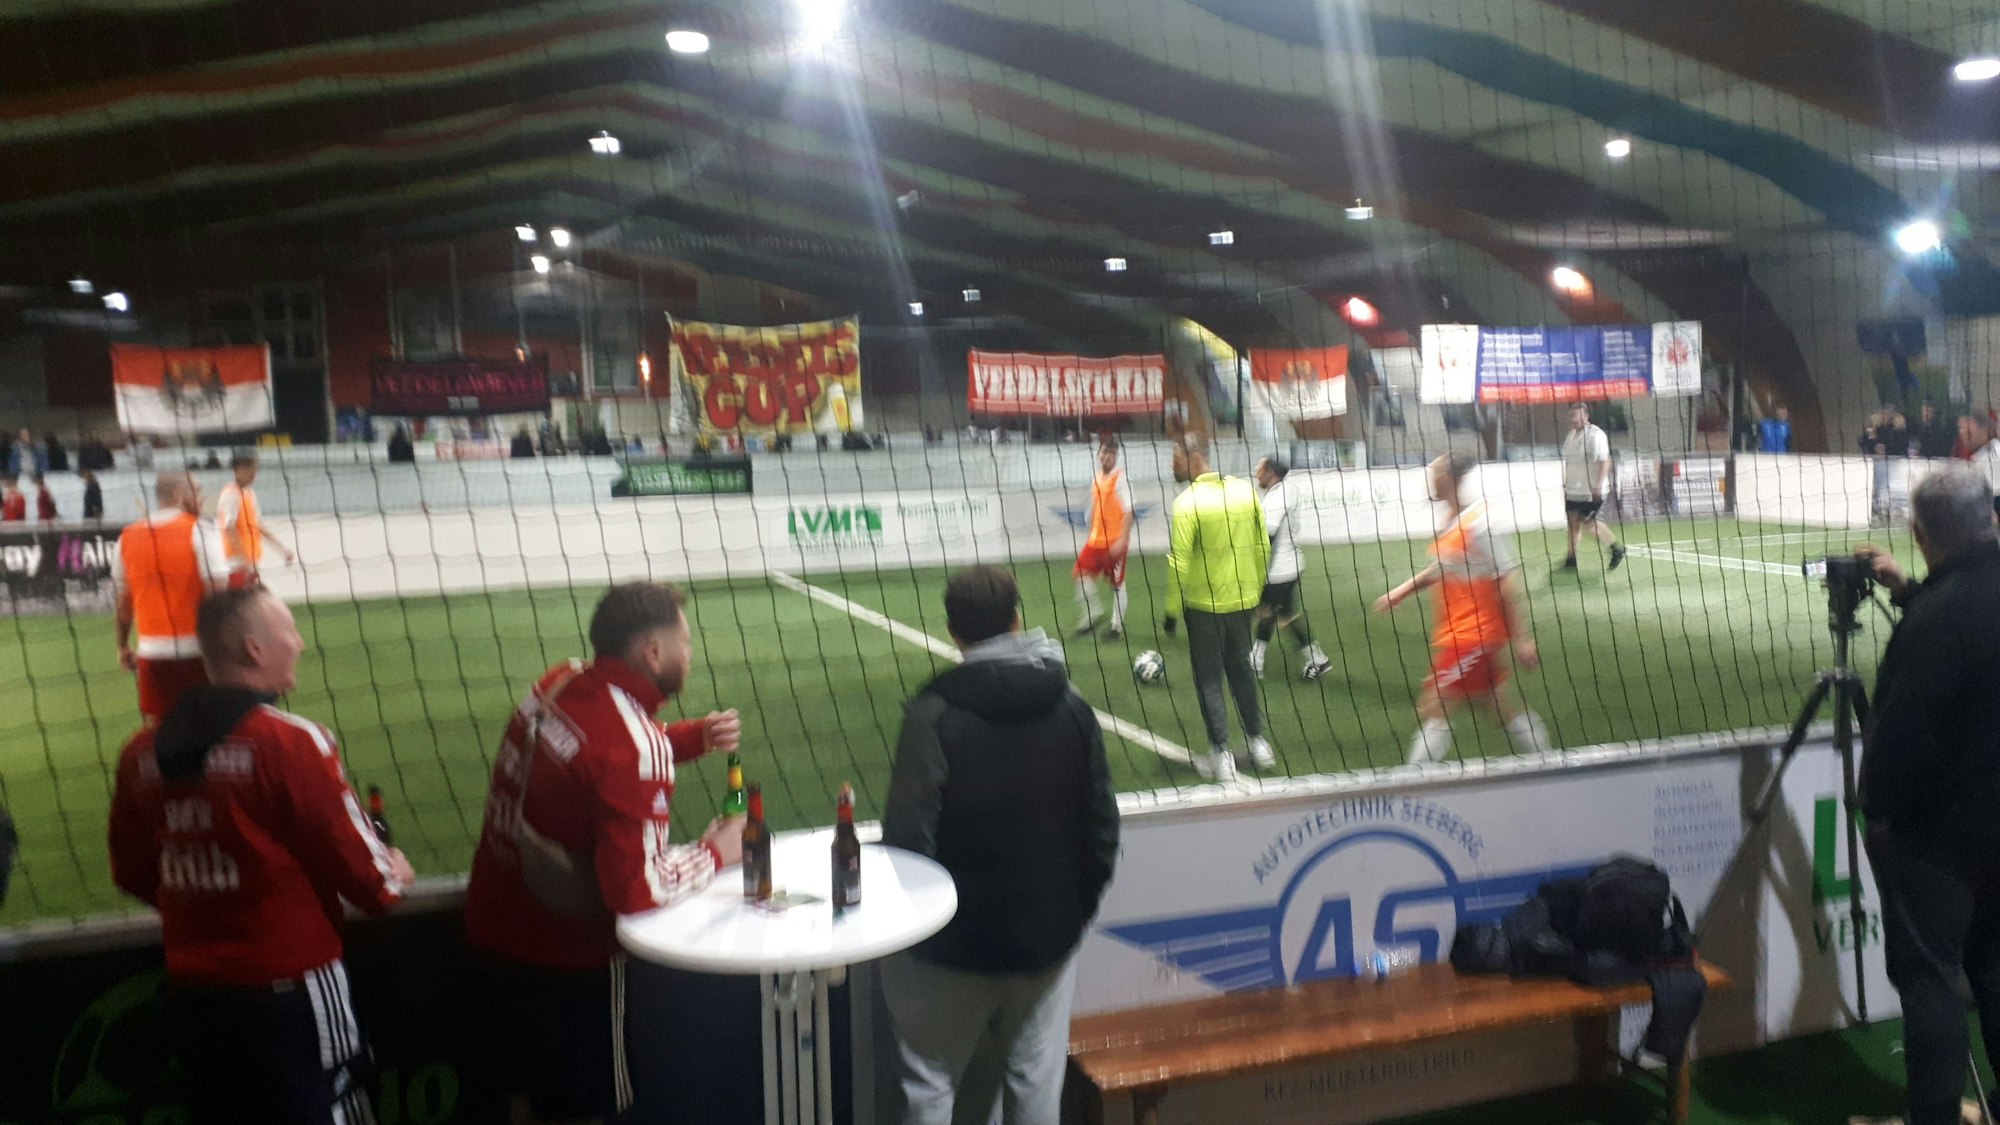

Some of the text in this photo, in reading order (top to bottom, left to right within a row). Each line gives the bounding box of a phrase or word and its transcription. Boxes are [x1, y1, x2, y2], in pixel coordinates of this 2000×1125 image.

[705, 369, 820, 429] CUP
[788, 504, 853, 535] LVM
[1252, 796, 1485, 885] AUTOTECHNIK SEEBERG
[1293, 886, 1455, 982] AS
